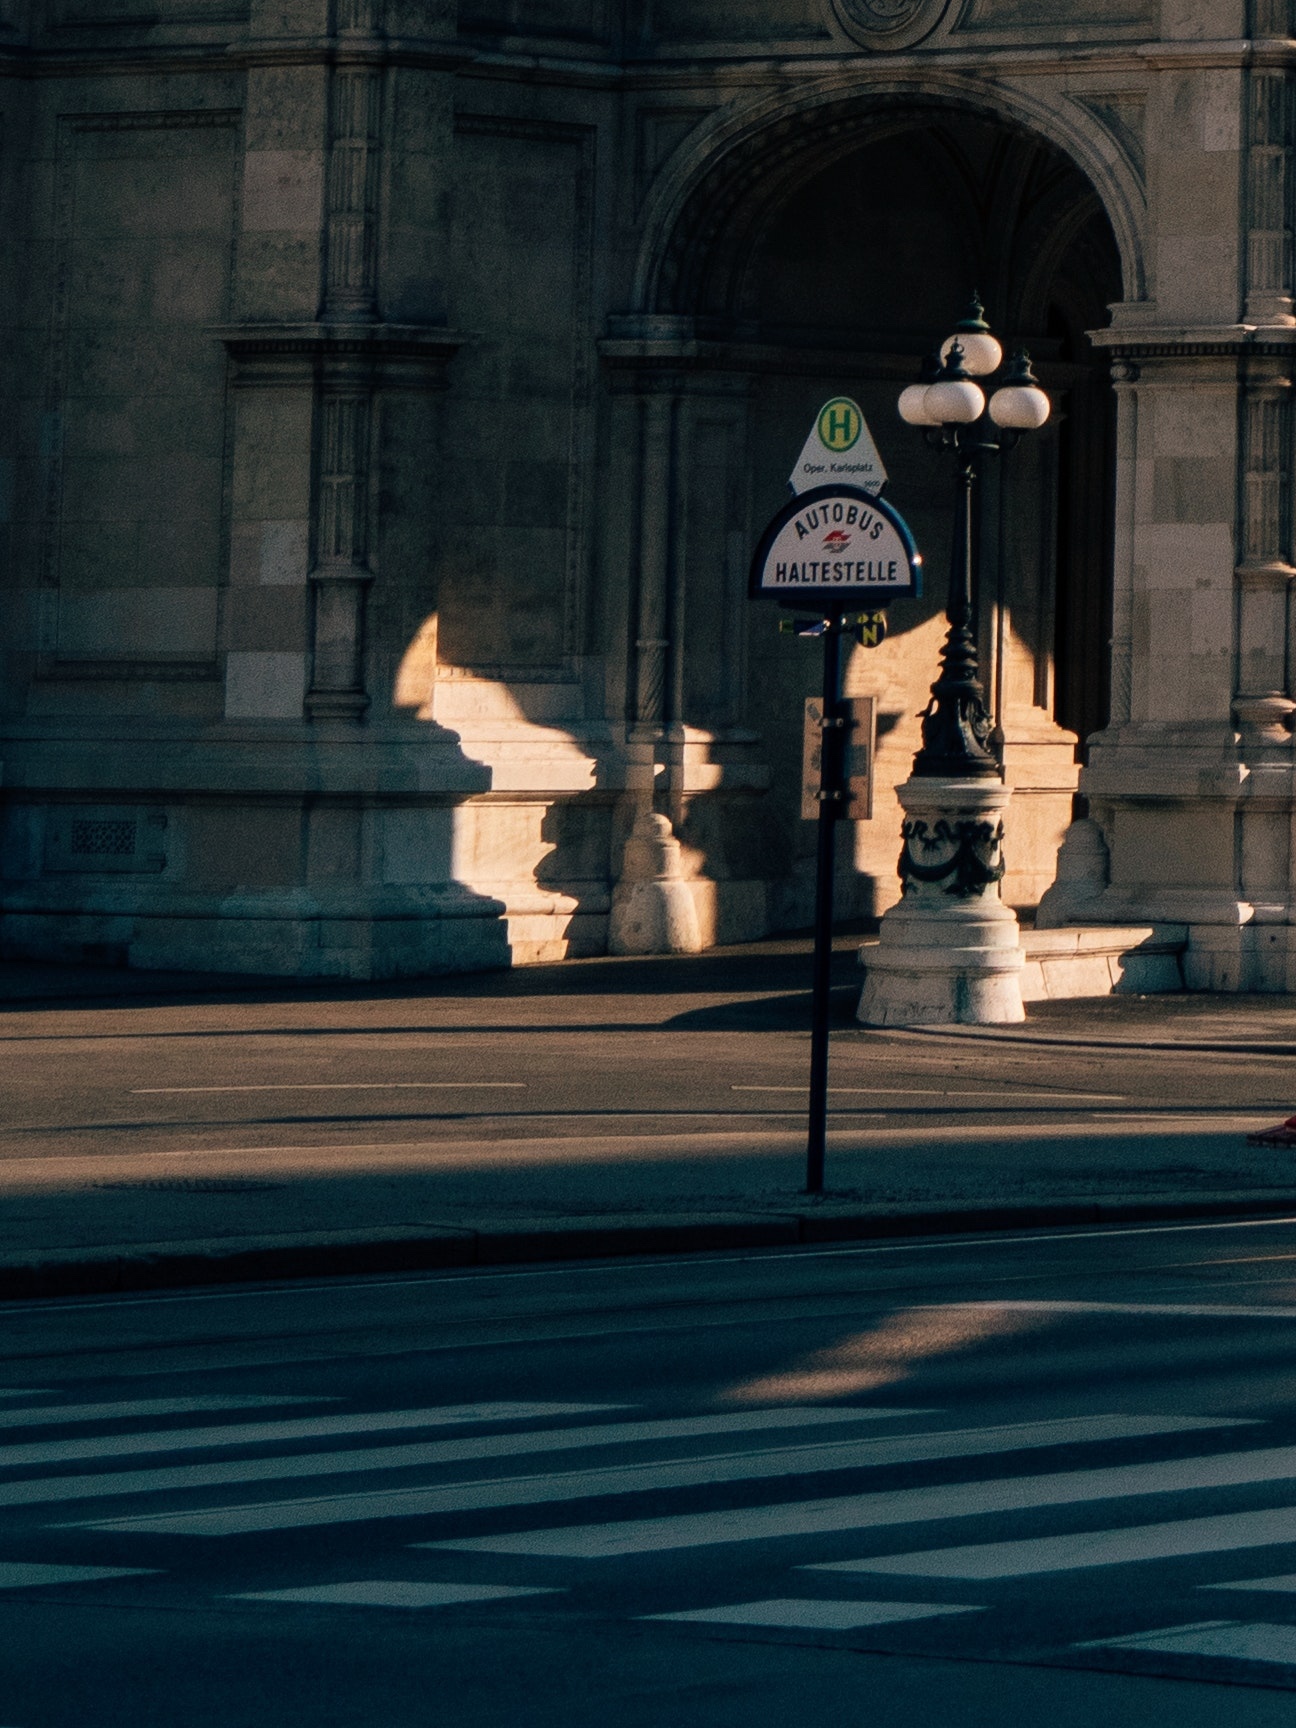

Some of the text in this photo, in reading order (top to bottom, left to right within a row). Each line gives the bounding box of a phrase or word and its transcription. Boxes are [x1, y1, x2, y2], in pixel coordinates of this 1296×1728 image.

[829, 409, 851, 442] H
[794, 503, 884, 540] AUTOBUS
[776, 561, 897, 583] HALTESTELLE
[862, 624, 877, 645] N
